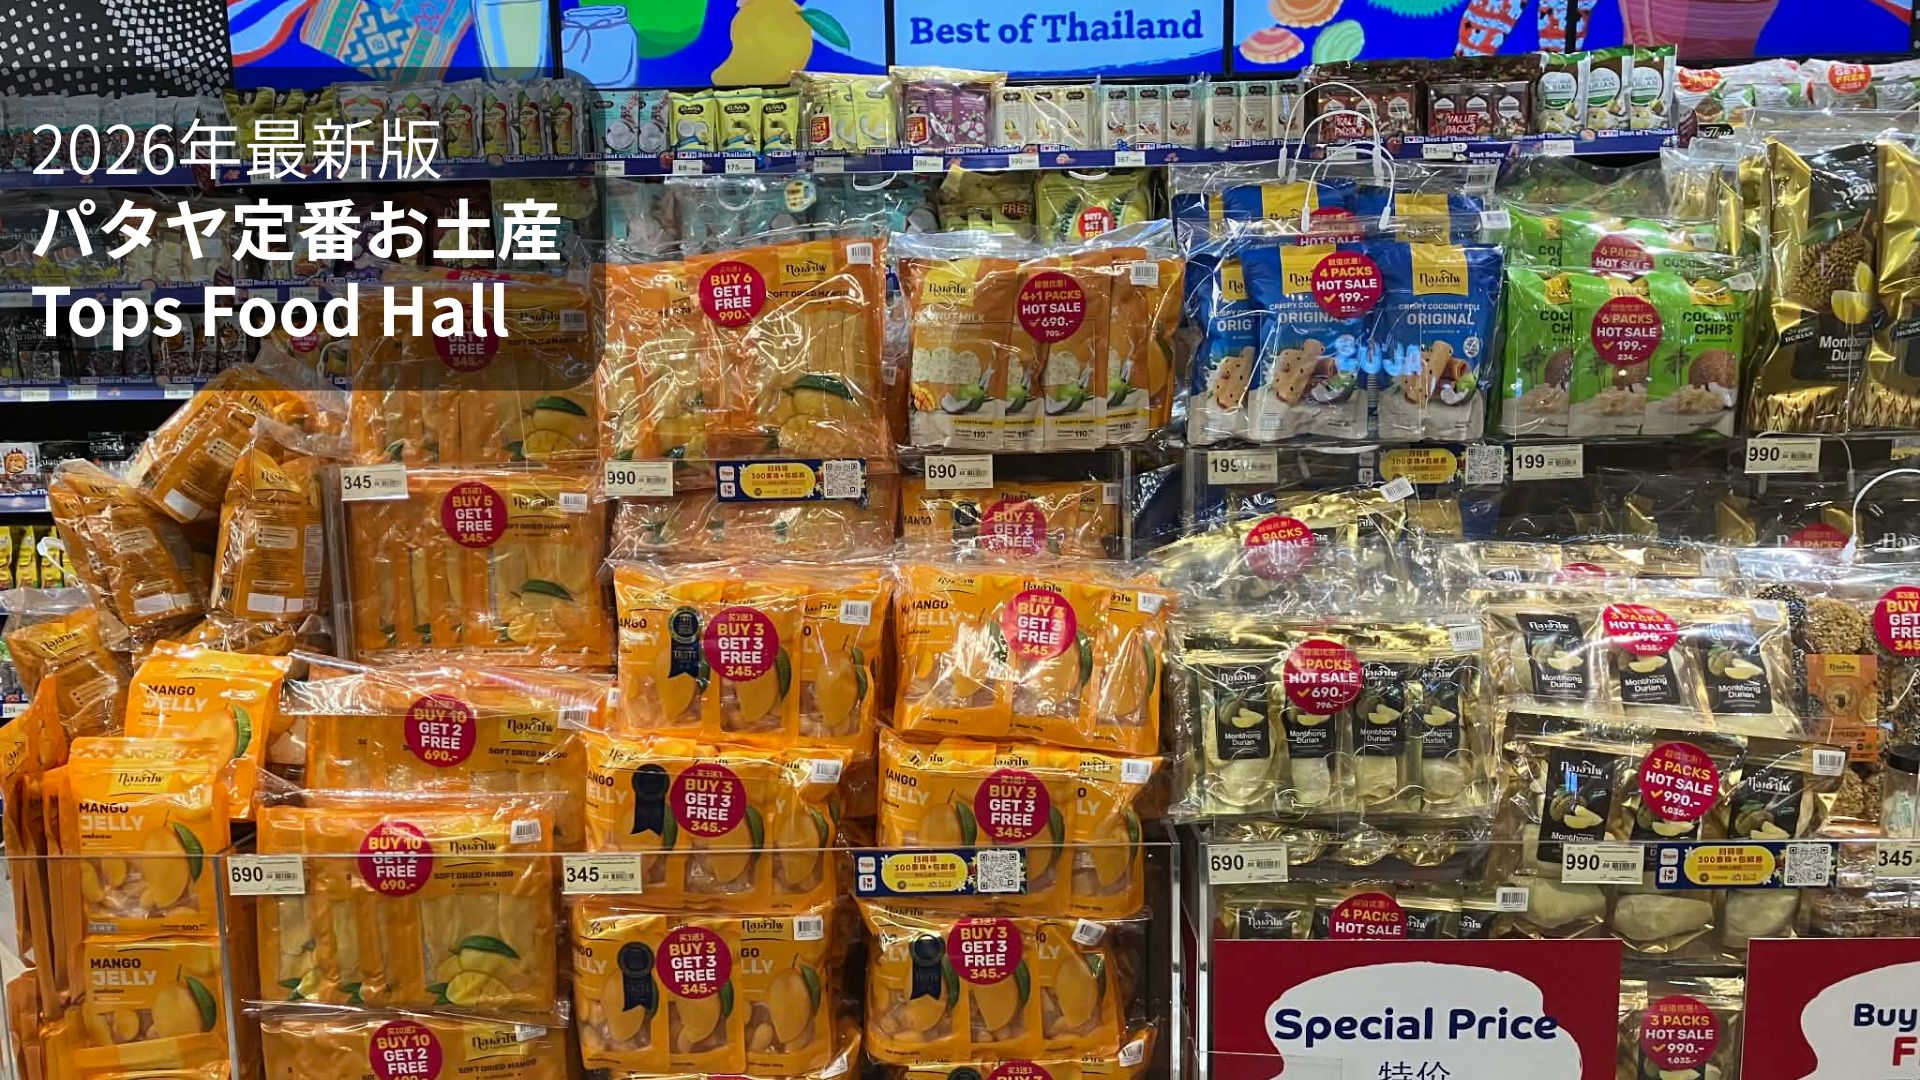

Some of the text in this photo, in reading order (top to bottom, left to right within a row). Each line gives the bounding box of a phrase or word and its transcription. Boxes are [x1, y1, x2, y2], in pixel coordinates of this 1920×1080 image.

[910, 10, 1203, 44] Best of Thailand
[1446, 113, 1477, 124] VALUE
[1330, 266, 1373, 278] PACKS
[710, 272, 753, 286] BUY 6
[1316, 278, 1378, 291] HOT SALE
[713, 285, 742, 298] GET
[1044, 290, 1082, 300] PACKS
[714, 296, 752, 311] FREE
[1022, 302, 1081, 315] HOT SALE
[1406, 313, 1476, 326] ORIGINAL
[1612, 314, 1654, 324] PACKS
[1682, 312, 1741, 323] COCONUT
[1596, 326, 1657, 338] HOT SALE
[1694, 324, 1733, 336] CHIPS
[1616, 340, 1648, 351] 199.-
[1515, 454, 1545, 468] 199
[1748, 447, 1780, 462] 990
[608, 470, 636, 485] 990
[928, 464, 956, 478] 690
[344, 476, 372, 490] 345
[452, 496, 480, 508] BUY
[456, 508, 482, 520] GET
[457, 520, 493, 532] FREE
[1886, 600, 1918, 614] BUY
[1609, 621, 1672, 631] HOT SALE
[1889, 613, 1920, 626] GET
[717, 623, 764, 636] BUY 3
[718, 637, 764, 650] GET 3
[720, 651, 762, 664] FREE
[1289, 672, 1357, 684] HOT SALE
[1542, 674, 1583, 686] Monthong
[1625, 676, 1668, 688] Monthong
[147, 684, 196, 696] MANGO
[1311, 686, 1349, 698] 690.-
[1550, 682, 1576, 690] Durian
[1634, 684, 1661, 692] Durian
[1718, 685, 1761, 696] Monthong
[1728, 690, 1754, 700] Durian
[143, 698, 208, 713] JELLY
[414, 708, 446, 722] BUY
[419, 722, 449, 735] GET
[420, 736, 461, 750] FREE
[1224, 732, 1262, 742] Monthong
[1652, 758, 1711, 780] 3 PACKS
[684, 778, 734, 792] BUY 3
[1645, 770, 1714, 796] HOT SALE
[989, 785, 1037, 798] BUY 3
[684, 793, 732, 806] GET 3
[1664, 790, 1701, 808] 990.-
[78, 802, 129, 815] MANGO
[989, 799, 1036, 814] GET 3
[686, 807, 728, 821] FREE
[990, 813, 1032, 826] FREE
[80, 815, 144, 832] JELLY
[995, 827, 1032, 838] 345.-
[1210, 855, 1244, 871] 690
[1566, 854, 1600, 870] 990
[1878, 850, 1912, 867] 345
[232, 867, 263, 883] 690
[566, 866, 599, 882] 345
[1340, 910, 1399, 922] 4 PACKS
[960, 926, 1008, 940] BUY 3
[1336, 922, 1401, 936] HOT SALE
[669, 942, 717, 956] BUY 3
[962, 940, 1008, 954] GET 3
[90, 958, 142, 970] MANGO
[670, 956, 717, 970] GET 3
[964, 954, 1006, 967] FREE
[92, 971, 158, 986] JELLY
[674, 969, 716, 983] FREE
[970, 968, 1007, 979] 345.-
[681, 983, 717, 995] 345.-
[1650, 1015, 1710, 1027] 3 PACKS
[1854, 1003, 1918, 1032] Buy
[1274, 1007, 1559, 1048] Special Price
[1646, 1028, 1714, 1041] HOT SALE
[377, 1034, 430, 1049] BUY 10
[1666, 1042, 1704, 1054] 990.-
[384, 1048, 428, 1062] GET 2
[388, 1061, 428, 1074] FREE
[484, 1063, 507, 1071] DRIED
